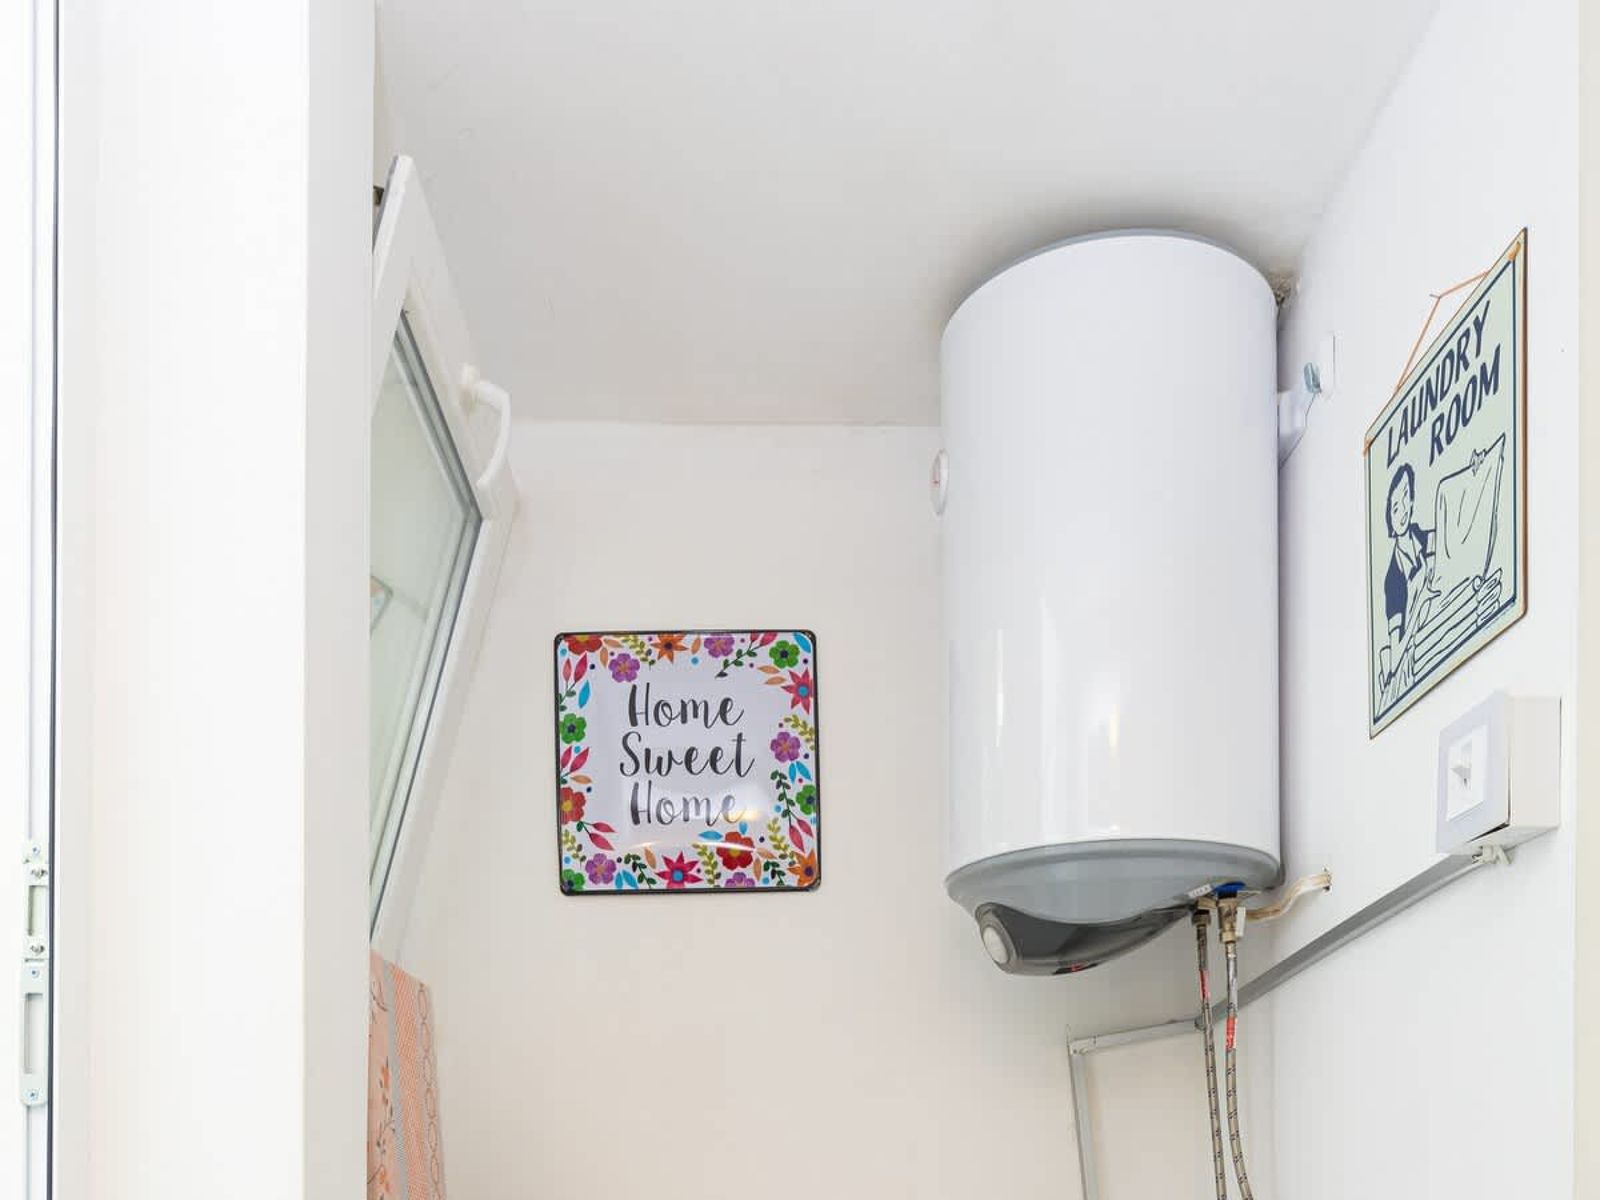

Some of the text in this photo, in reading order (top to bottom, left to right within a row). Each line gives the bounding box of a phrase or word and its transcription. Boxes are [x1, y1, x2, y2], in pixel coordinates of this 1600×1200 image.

[1386, 299, 1490, 470] LAUNDRY
[1428, 343, 1501, 467] ROOM
[627, 682, 744, 729] Home
[619, 731, 755, 777] Sweet
[630, 780, 747, 827] Home
